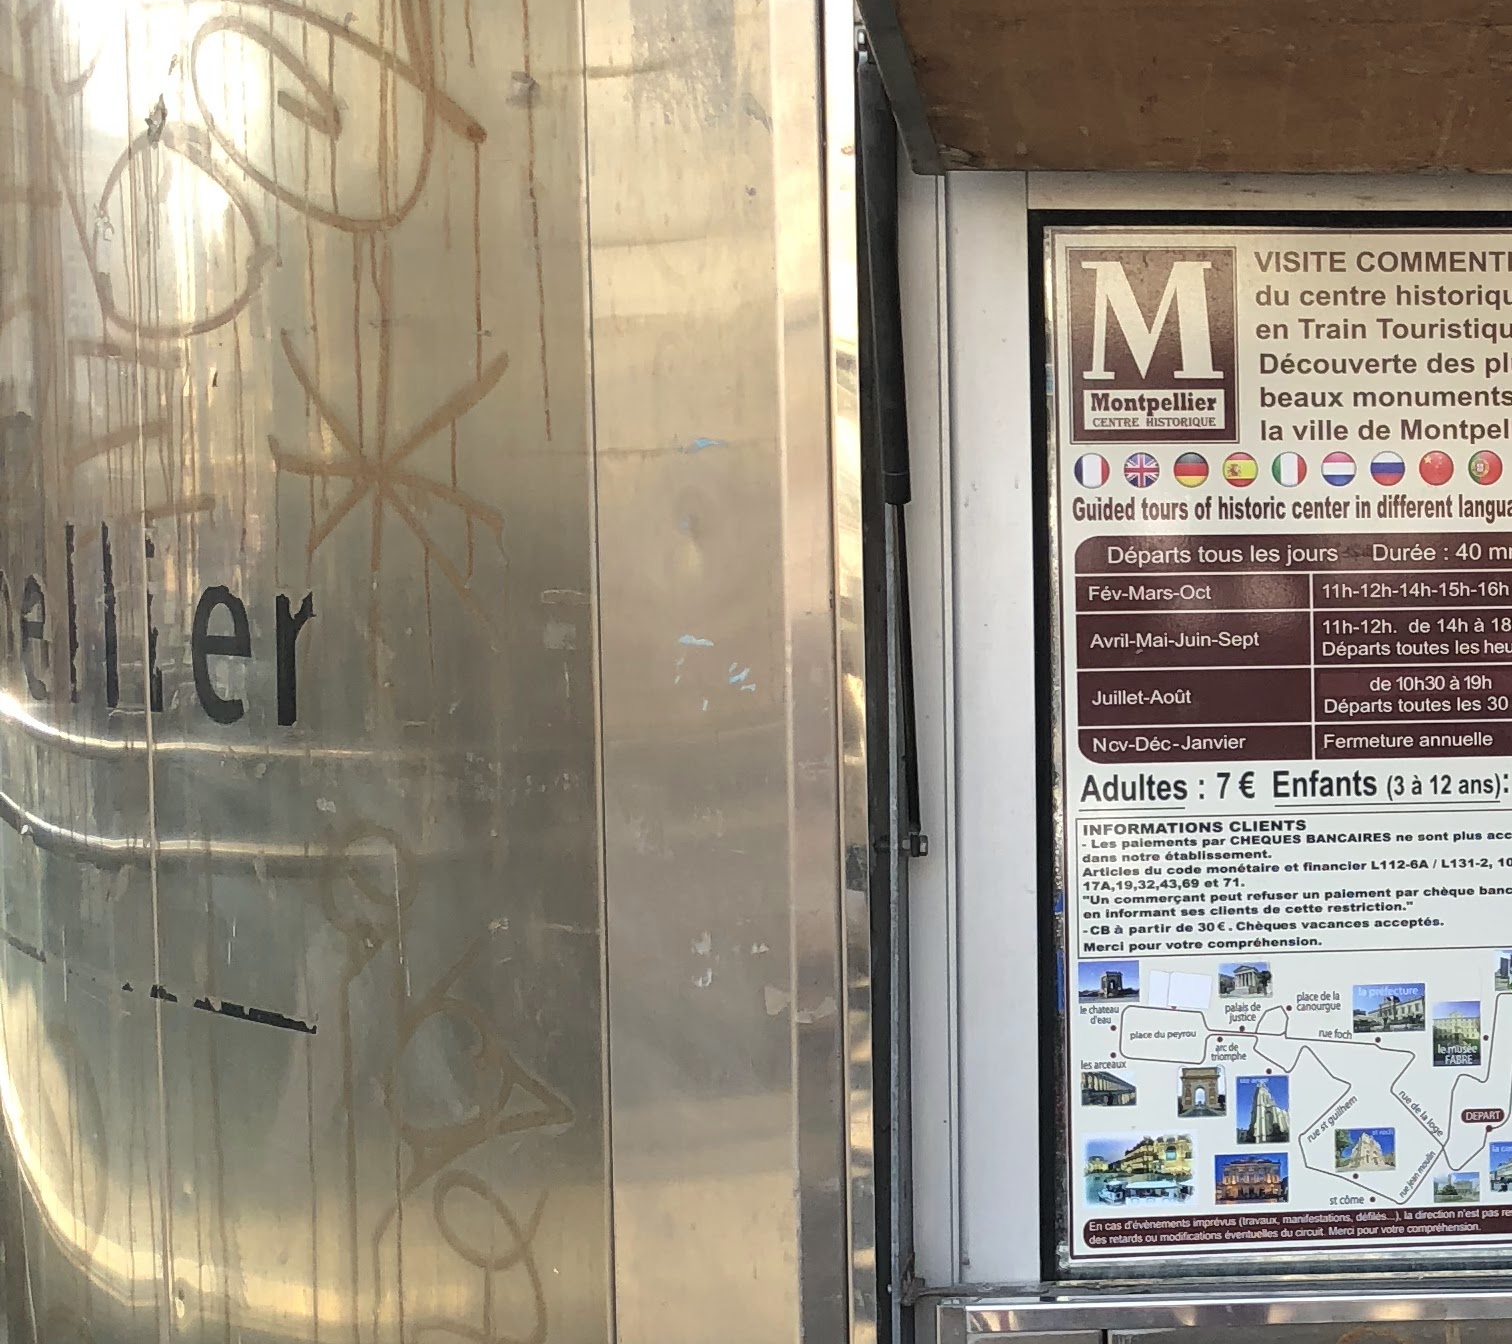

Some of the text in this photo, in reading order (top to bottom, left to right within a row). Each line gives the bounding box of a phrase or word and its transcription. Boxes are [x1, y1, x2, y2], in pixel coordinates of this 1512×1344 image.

[1254, 250, 1347, 273] VISITE
[1255, 284, 1290, 307] du
[1299, 287, 1387, 307] centre
[1081, 261, 1225, 381] M
[1255, 323, 1290, 341] en
[1298, 317, 1368, 341] Train
[1259, 352, 1418, 376] Découverte
[1426, 352, 1476, 375] des
[1091, 392, 1218, 417] Montpellier
[1260, 386, 1344, 408] beaux
[1092, 415, 1217, 429] CENTRE HISTORIQUE
[1261, 419, 1284, 442] la
[1292, 418, 1349, 442] ville
[1358, 418, 1392, 441] de
[1072, 496, 1136, 522] Guided
[1142, 498, 1189, 522] tours
[1194, 495, 1213, 521] of
[1218, 494, 1287, 521] historic
[1292, 496, 1351, 520] center
[1355, 494, 1372, 519] in
[1377, 493, 1454, 520] different
[1107, 545, 1192, 569] Départs
[1198, 546, 1244, 564] tous
[1250, 544, 1281, 563] les
[1285, 544, 1339, 567] jours
[1372, 542, 1437, 563] Durée
[1455, 542, 1482, 562] 40
[1088, 582, 1511, 602] Fév-Mars-Oct 11h-12h-14h-15h-16h
[1322, 618, 1398, 636] 11h-12h.
[1408, 618, 1432, 634] de
[1437, 617, 1469, 634] 14h
[1473, 618, 1486, 633] à
[1090, 630, 1260, 651] Avril-Mai-Juin-Sept
[1322, 639, 1392, 660] Départs
[1396, 640, 1450, 656] toutes
[1455, 639, 1481, 655] les
[1369, 674, 1493, 693] de 10h30 à 19h
[1091, 688, 1193, 707] Juillet-Août
[1323, 698, 1393, 717] Départs
[1397, 698, 1452, 714] toutes
[1456, 696, 1482, 713] les
[1487, 696, 1509, 712] 30
[1323, 733, 1415, 750] Fermeture
[1418, 731, 1494, 748] annuelle
[1079, 772, 1189, 803] Adultes
[1216, 771, 1231, 800] 7
[1238, 771, 1257, 800] €
[1272, 769, 1378, 799] Enfants
[1386, 774, 1405, 802] (3
[1411, 775, 1423, 796] à
[1429, 774, 1452, 795] 12
[1082, 819, 1308, 837] INFORMATIONS CLIENTS
[1465, 1110, 1501, 1122] DEPART
